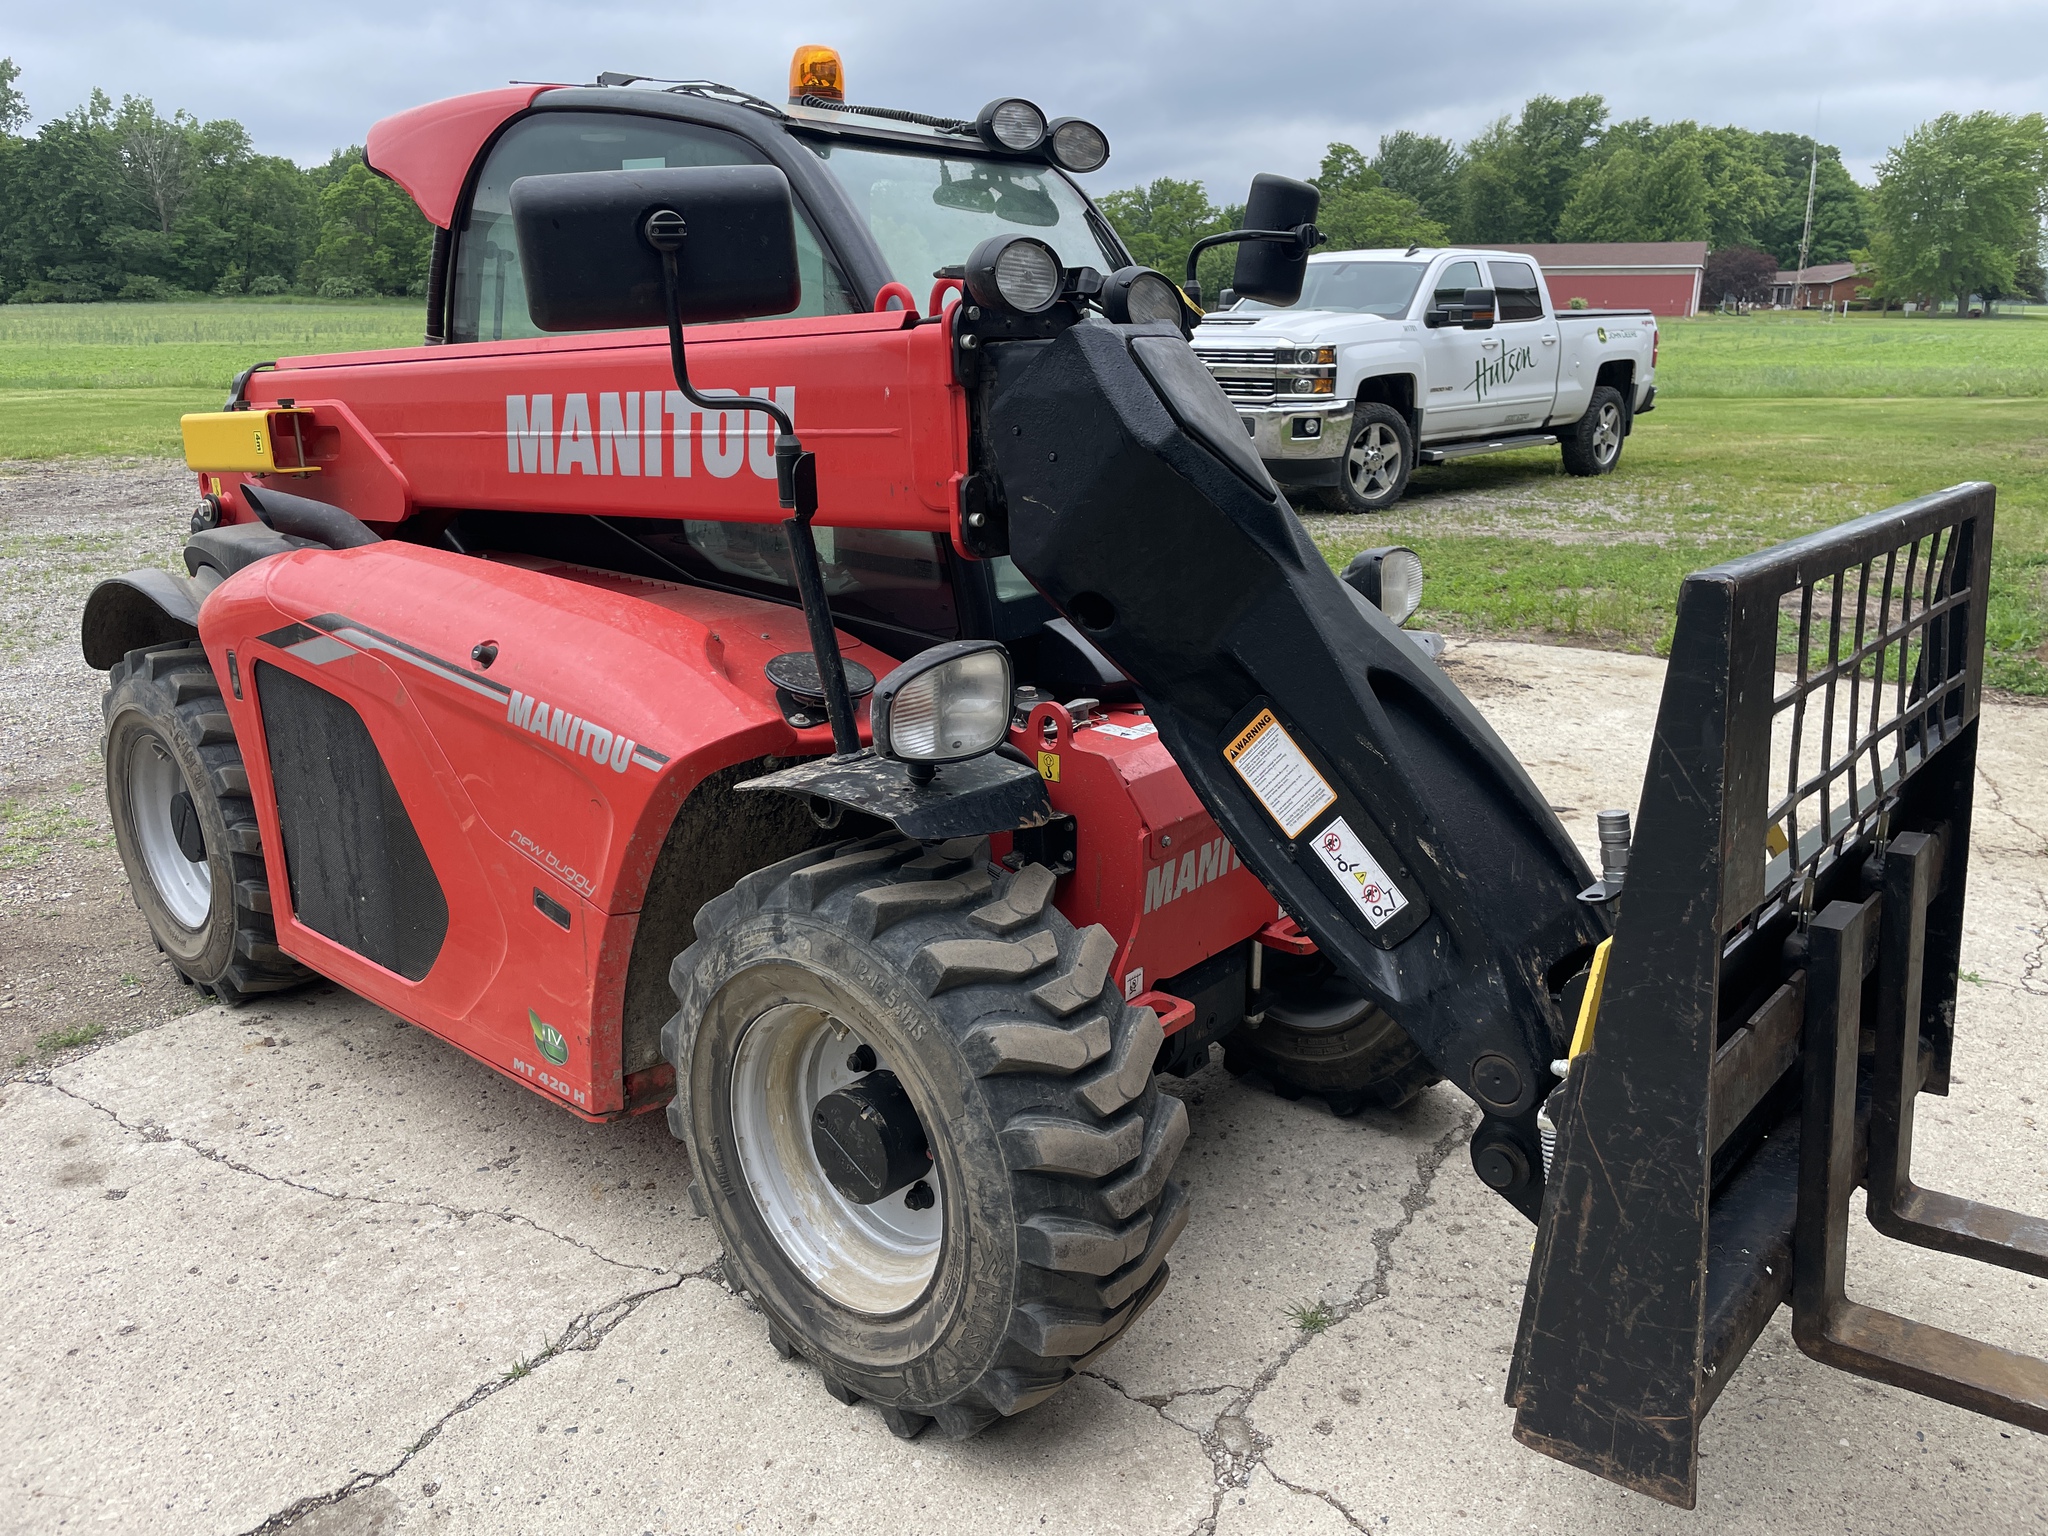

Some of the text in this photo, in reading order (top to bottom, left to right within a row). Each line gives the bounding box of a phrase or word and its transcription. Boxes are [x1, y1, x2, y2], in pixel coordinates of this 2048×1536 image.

[1463, 338, 1539, 403] Hutson
[505, 386, 796, 480] MANITOU
[507, 689, 637, 773] MANITOU
[1235, 714, 1272, 751] WARNING
[510, 829, 597, 896] new buggy
[1143, 836, 1241, 915] MANI
[547, 1027, 562, 1046] IV
[512, 1057, 586, 1105] MT 420 H
